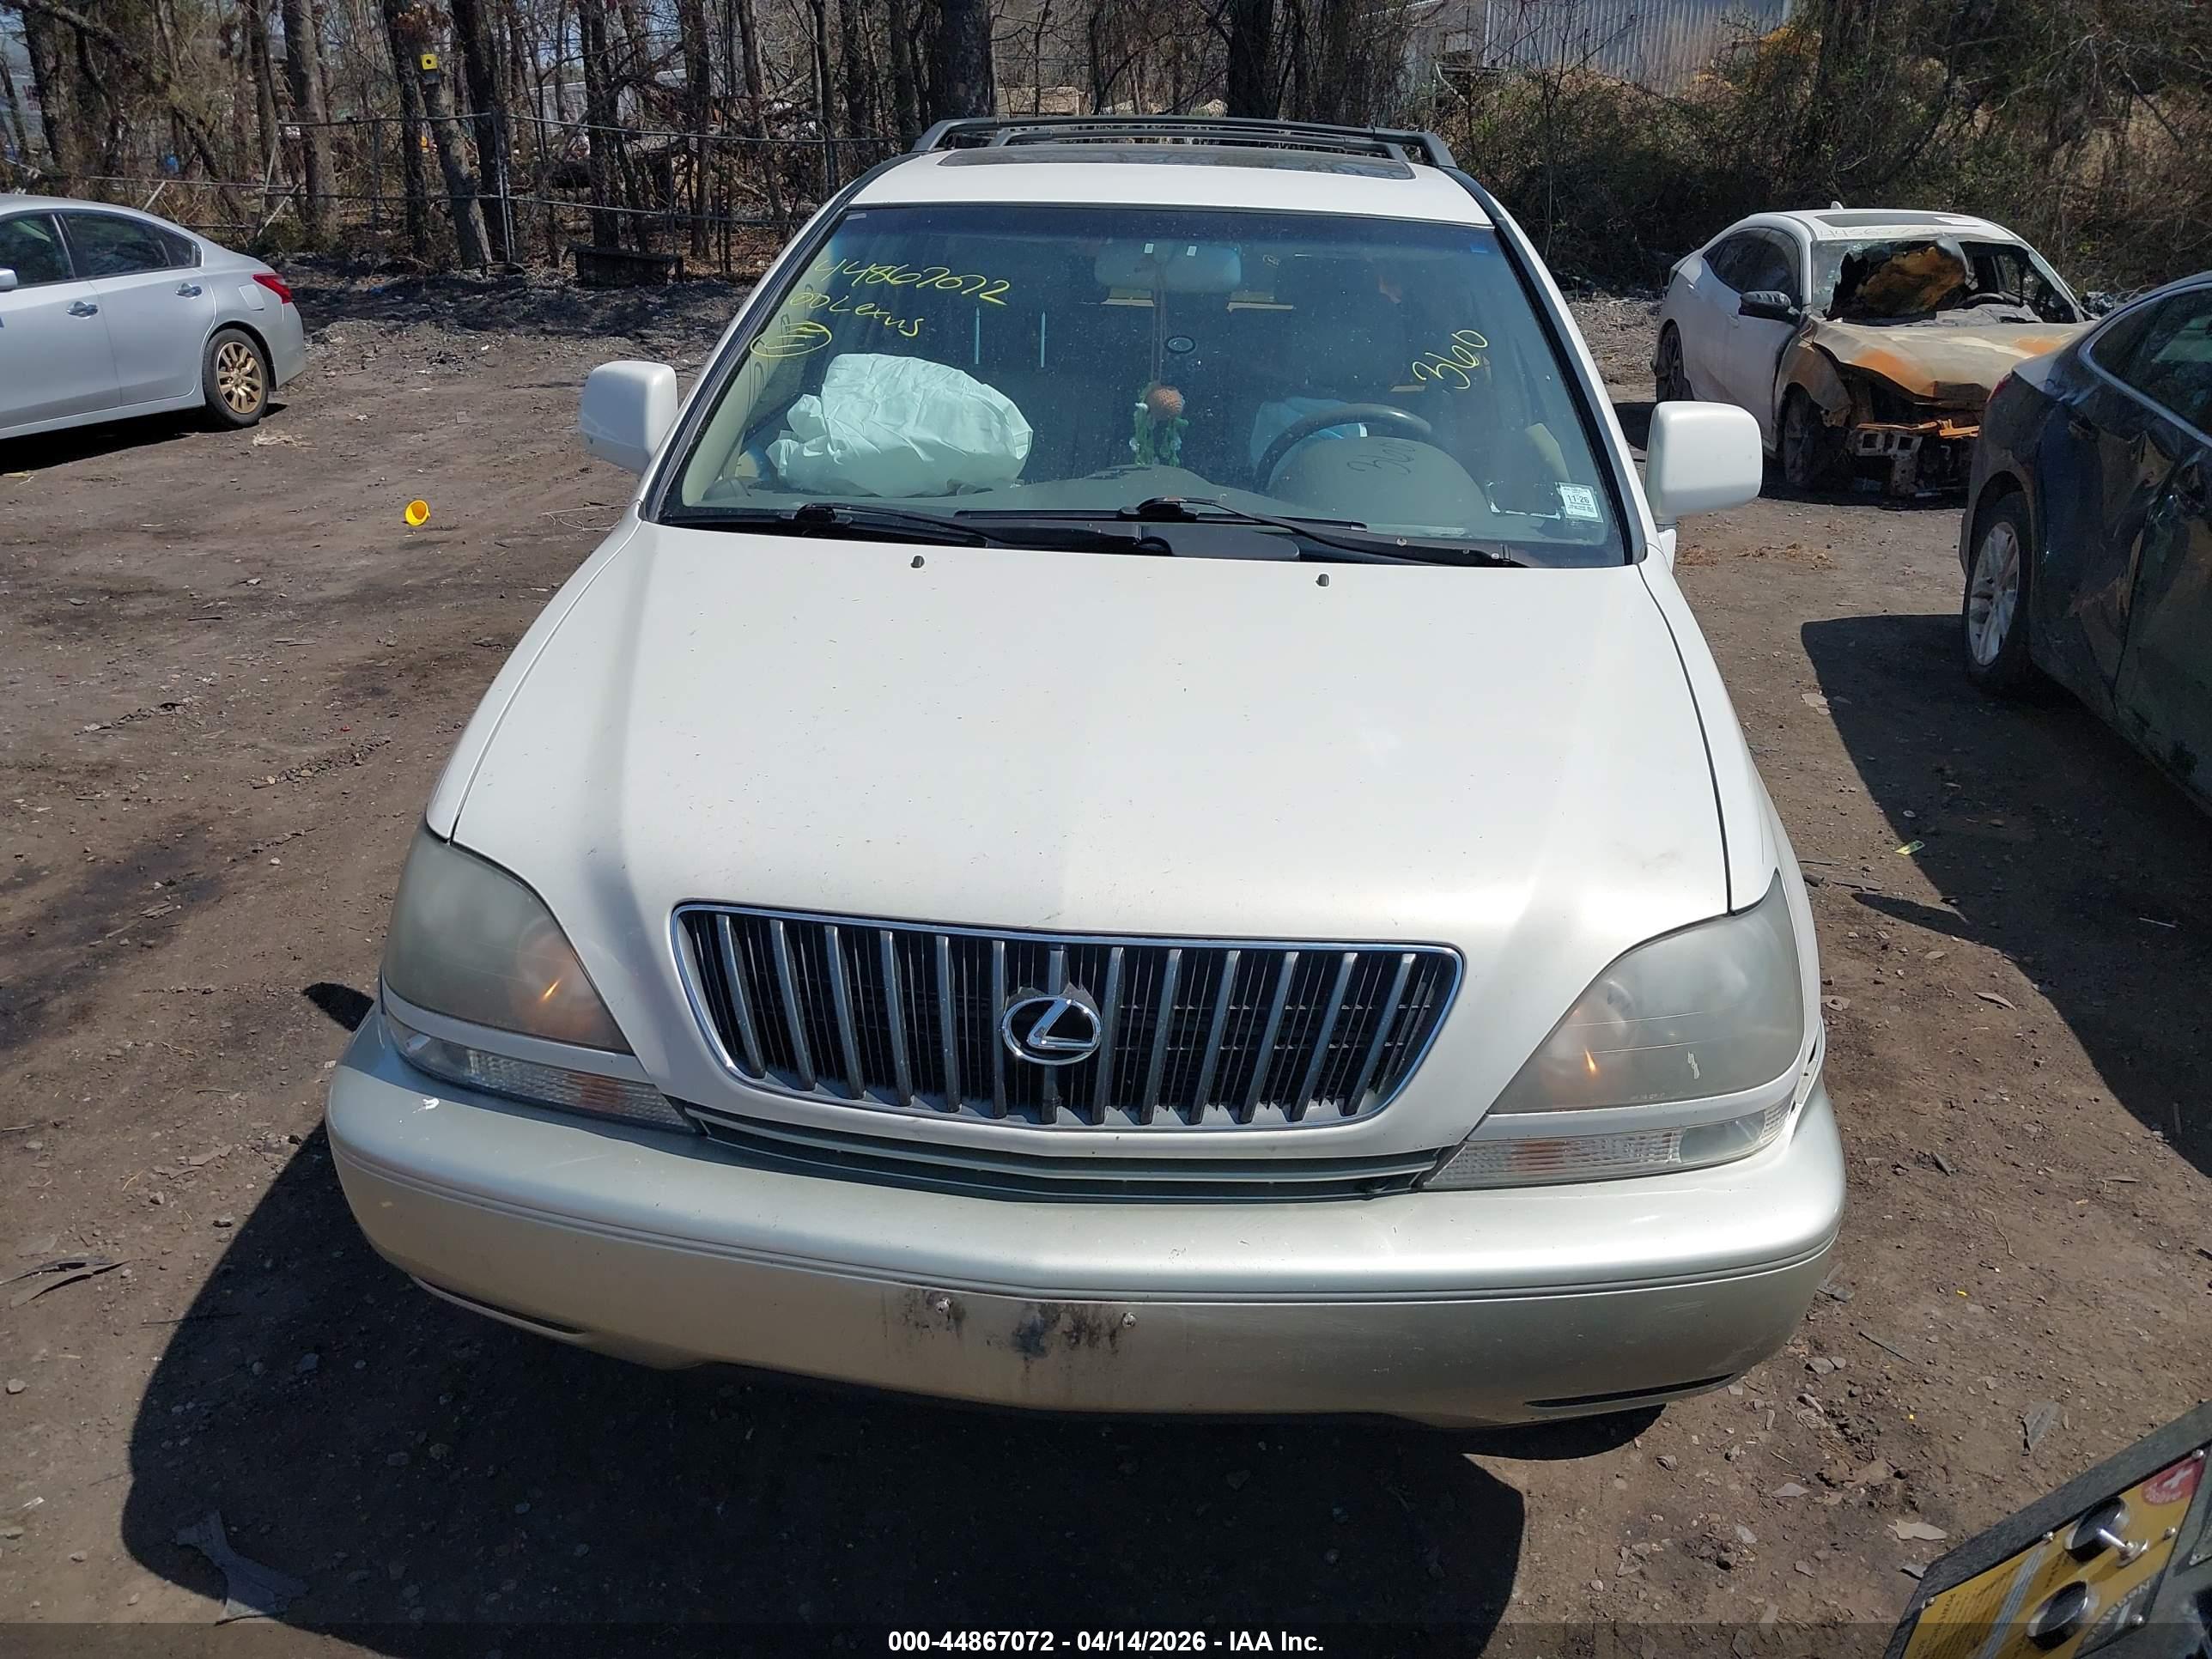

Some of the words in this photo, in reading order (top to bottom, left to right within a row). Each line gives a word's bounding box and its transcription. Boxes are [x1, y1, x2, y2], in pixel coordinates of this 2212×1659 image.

[815, 258, 1011, 306] 44867072
[1412, 330, 1488, 389] 360
[1567, 494, 1590, 504] 11-26
